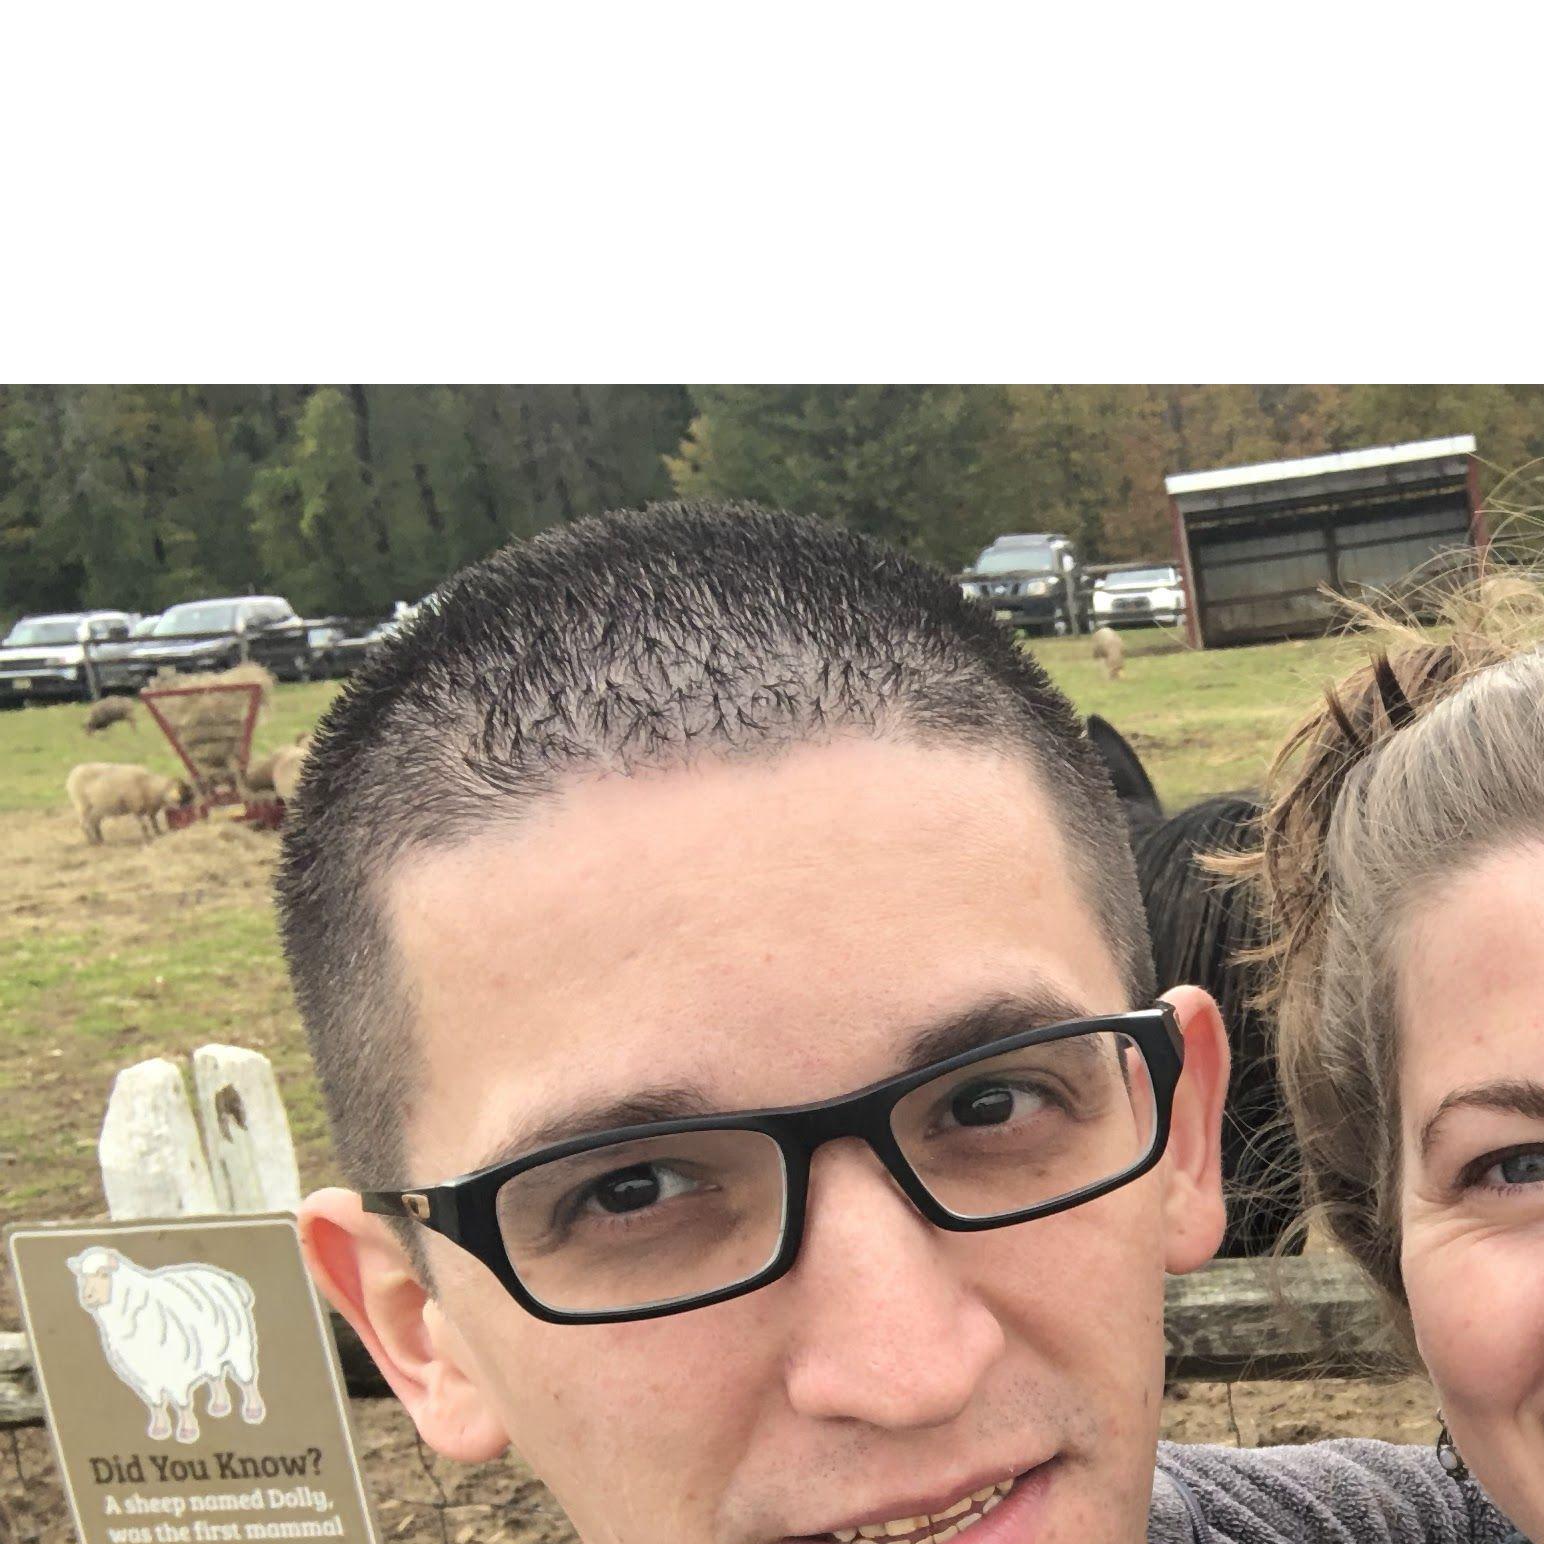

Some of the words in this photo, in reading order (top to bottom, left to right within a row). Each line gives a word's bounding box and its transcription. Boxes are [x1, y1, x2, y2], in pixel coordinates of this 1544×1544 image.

[89, 1454, 144, 1484] Did
[149, 1456, 210, 1482] You
[213, 1447, 322, 1479] Know?
[104, 1494, 122, 1515] A
[124, 1492, 186, 1517] sheep
[189, 1488, 265, 1512] named
[108, 1527, 152, 1544] was
[155, 1523, 191, 1543] the
[193, 1520, 241, 1541] first
[244, 1515, 344, 1539] mammal
